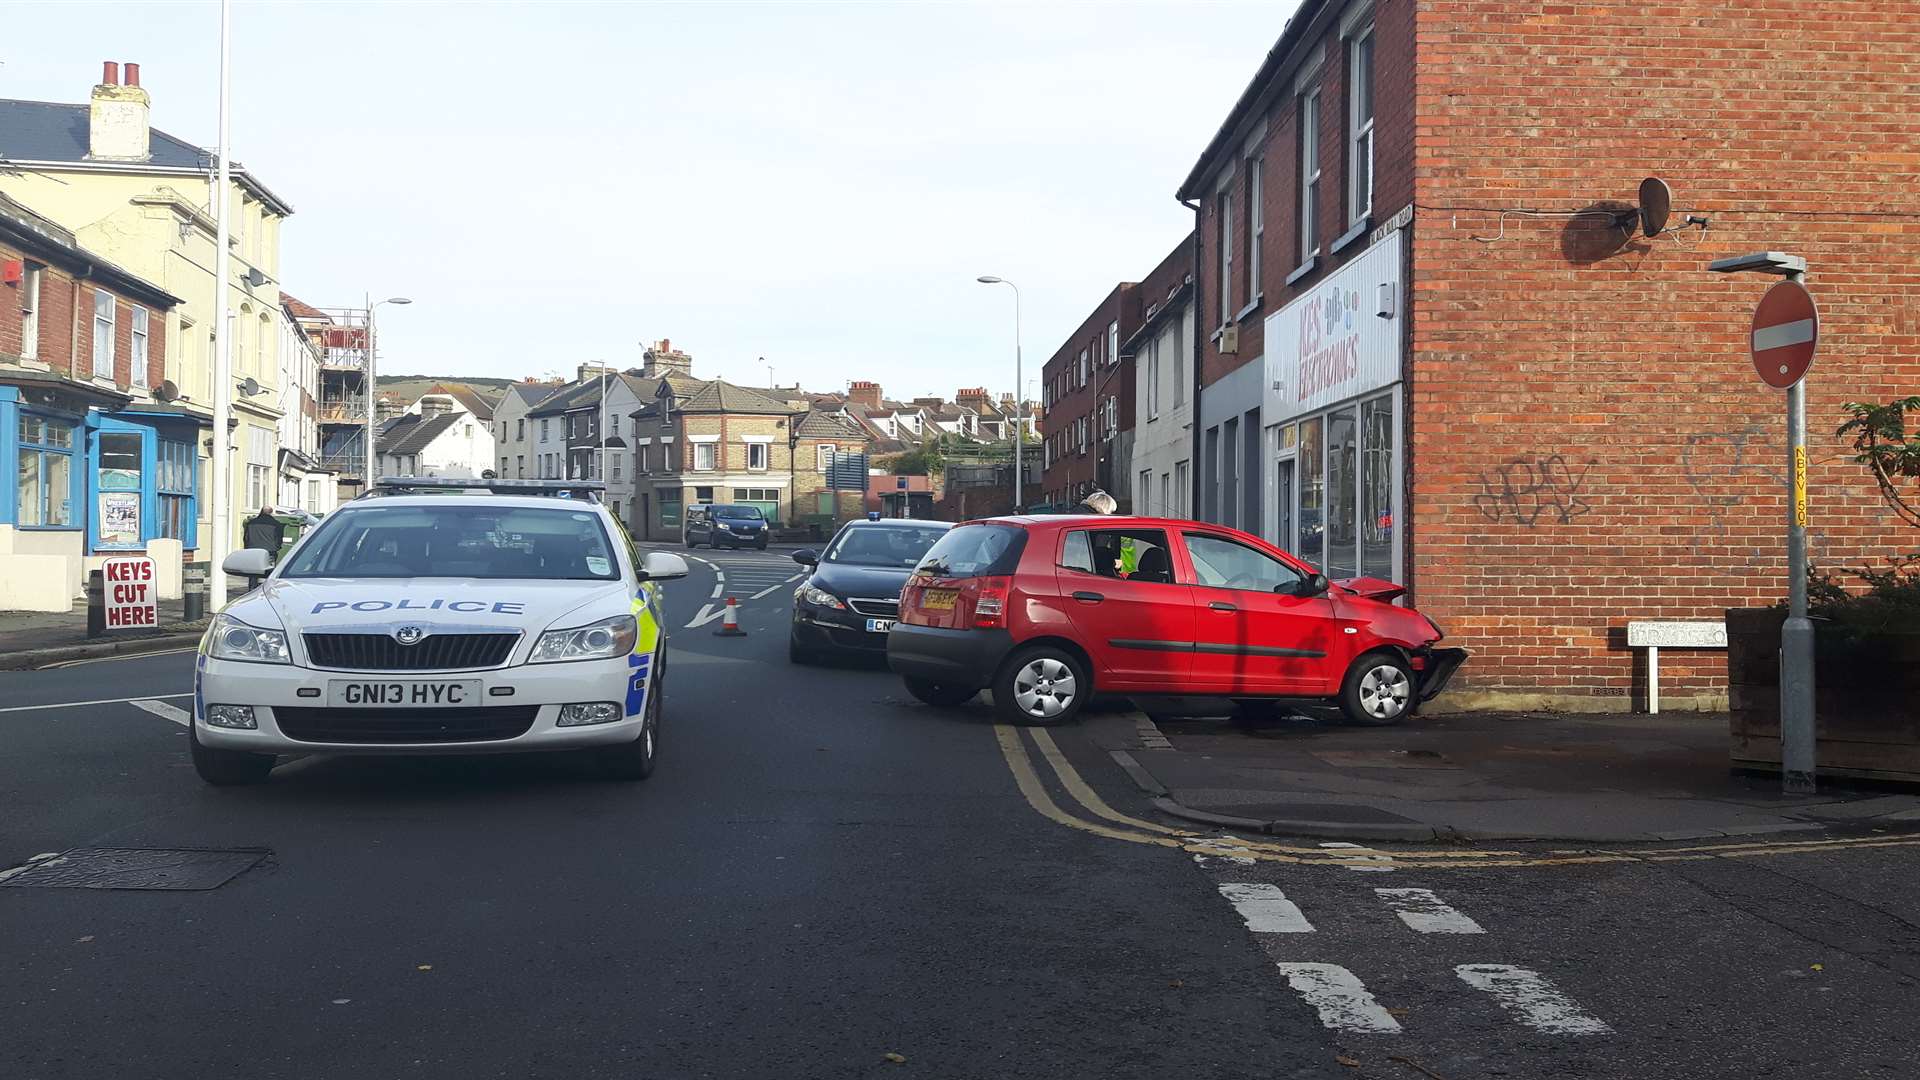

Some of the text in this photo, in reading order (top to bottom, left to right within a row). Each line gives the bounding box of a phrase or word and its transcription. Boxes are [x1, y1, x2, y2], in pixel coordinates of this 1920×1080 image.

[1399, 204, 1411, 227] ROAD
[1299, 333, 1359, 402] ELECTRONICS
[1796, 448, 1805, 490] NBKV
[107, 561, 152, 581] KEYS
[113, 584, 147, 604] CUT
[108, 606, 155, 626] HERE
[311, 599, 526, 615] POLICE
[345, 684, 463, 704] GN13 HYC
